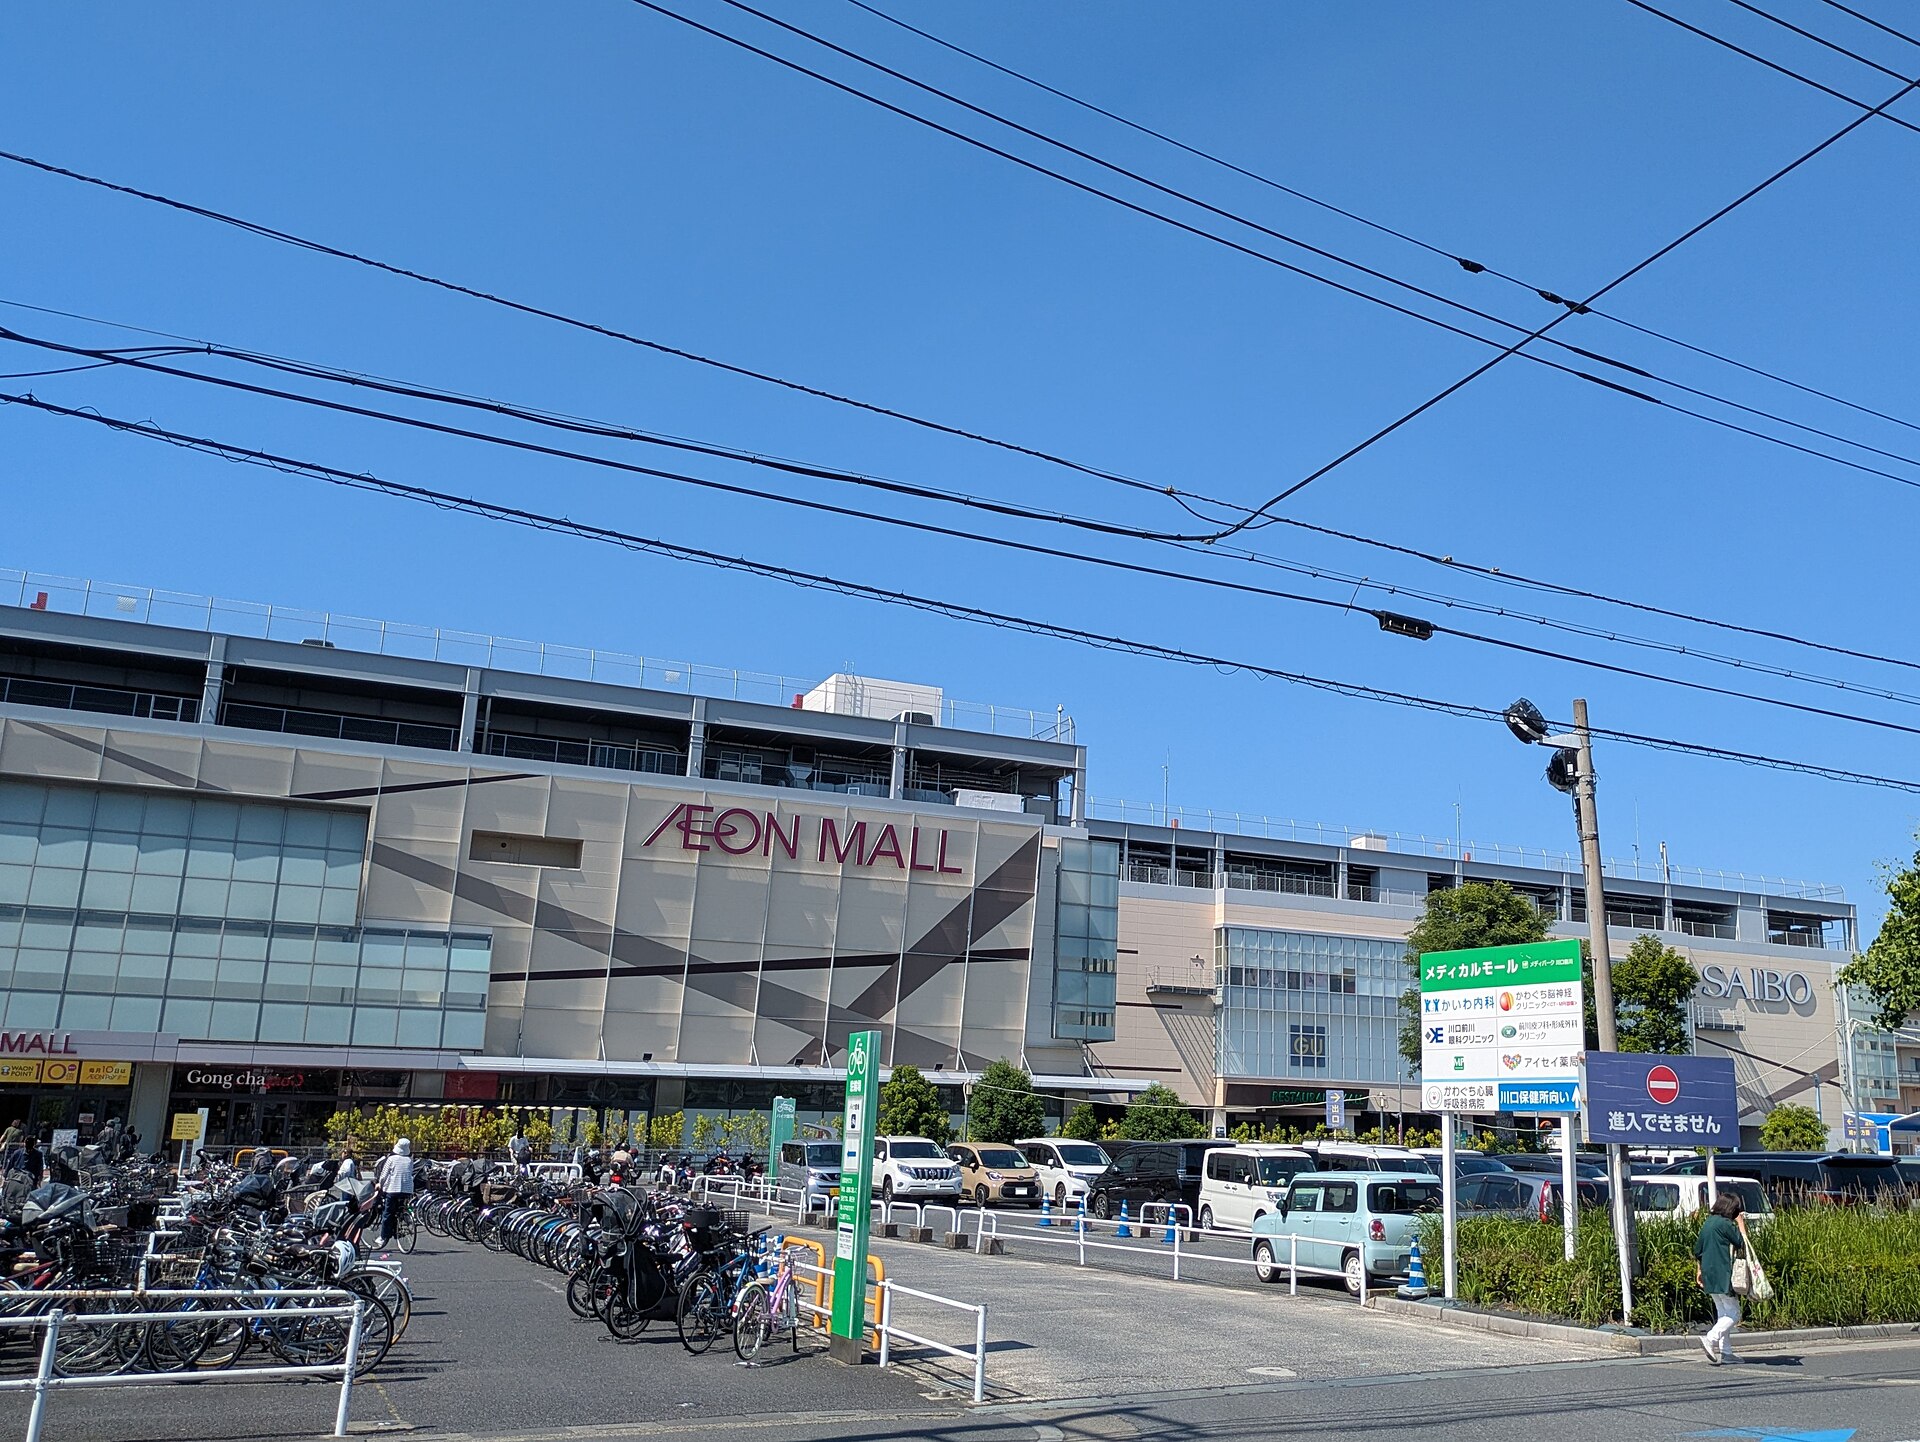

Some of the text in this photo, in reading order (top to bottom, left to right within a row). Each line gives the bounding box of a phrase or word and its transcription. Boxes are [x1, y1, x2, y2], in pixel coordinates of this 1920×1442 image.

[818, 818, 962, 873] MALL
[1424, 958, 1519, 981] メディカルモール
[1701, 964, 1812, 1006] SAIBO
[1515, 987, 1573, 1001] かわぐち脳神経
[1441, 995, 1495, 1012] かいわ内科
[1515, 1001, 1547, 1011] クリニック
[1448, 1023, 1476, 1033] 川口前川
[1518, 1031, 1547, 1041] クリニック
[0, 1032, 77, 1054] MALL
[1294, 1036, 1323, 1055] GU
[1448, 1034, 1495, 1045] 眼科クリニック
[1524, 1055, 1579, 1069] アイセイ薬局
[186, 1069, 266, 1089] Gong cha
[1443, 1084, 1494, 1098] かわぐち心臓
[1500, 1089, 1570, 1105] 川口保健所向い
[1443, 1097, 1486, 1110] 呼吸器病院
[1331, 1104, 1340, 1123] 出口
[1607, 1110, 1721, 1135] 進入できません
